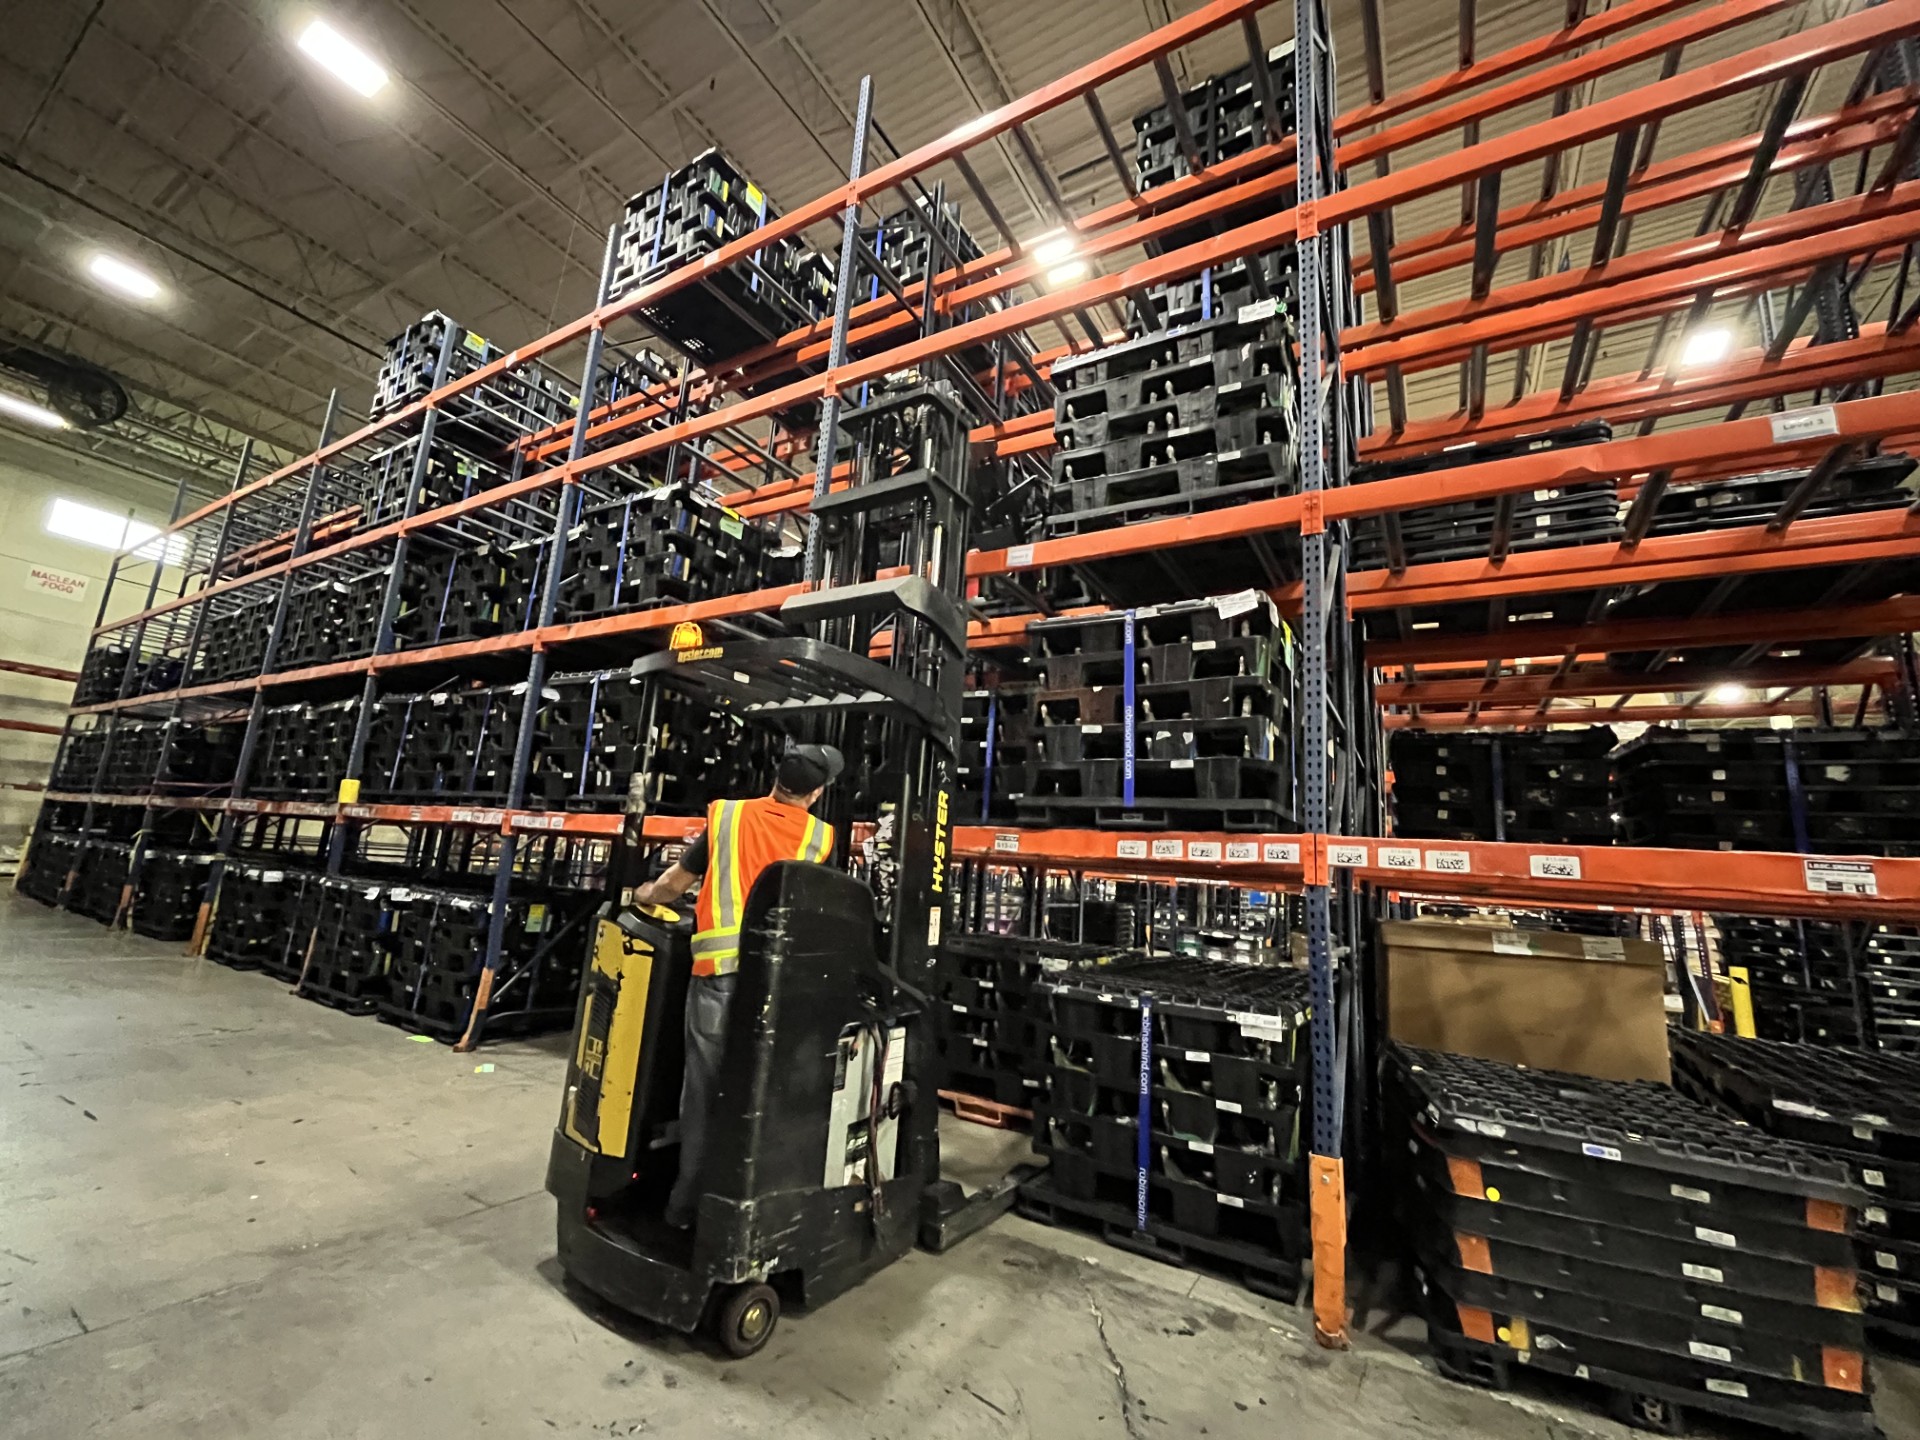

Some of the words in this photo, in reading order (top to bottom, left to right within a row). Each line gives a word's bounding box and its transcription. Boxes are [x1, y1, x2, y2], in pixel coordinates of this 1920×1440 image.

[31, 569, 86, 588] MACLEAN
[1124, 705, 1134, 780] robinsonind.com
[931, 790, 949, 893] HYSTER
